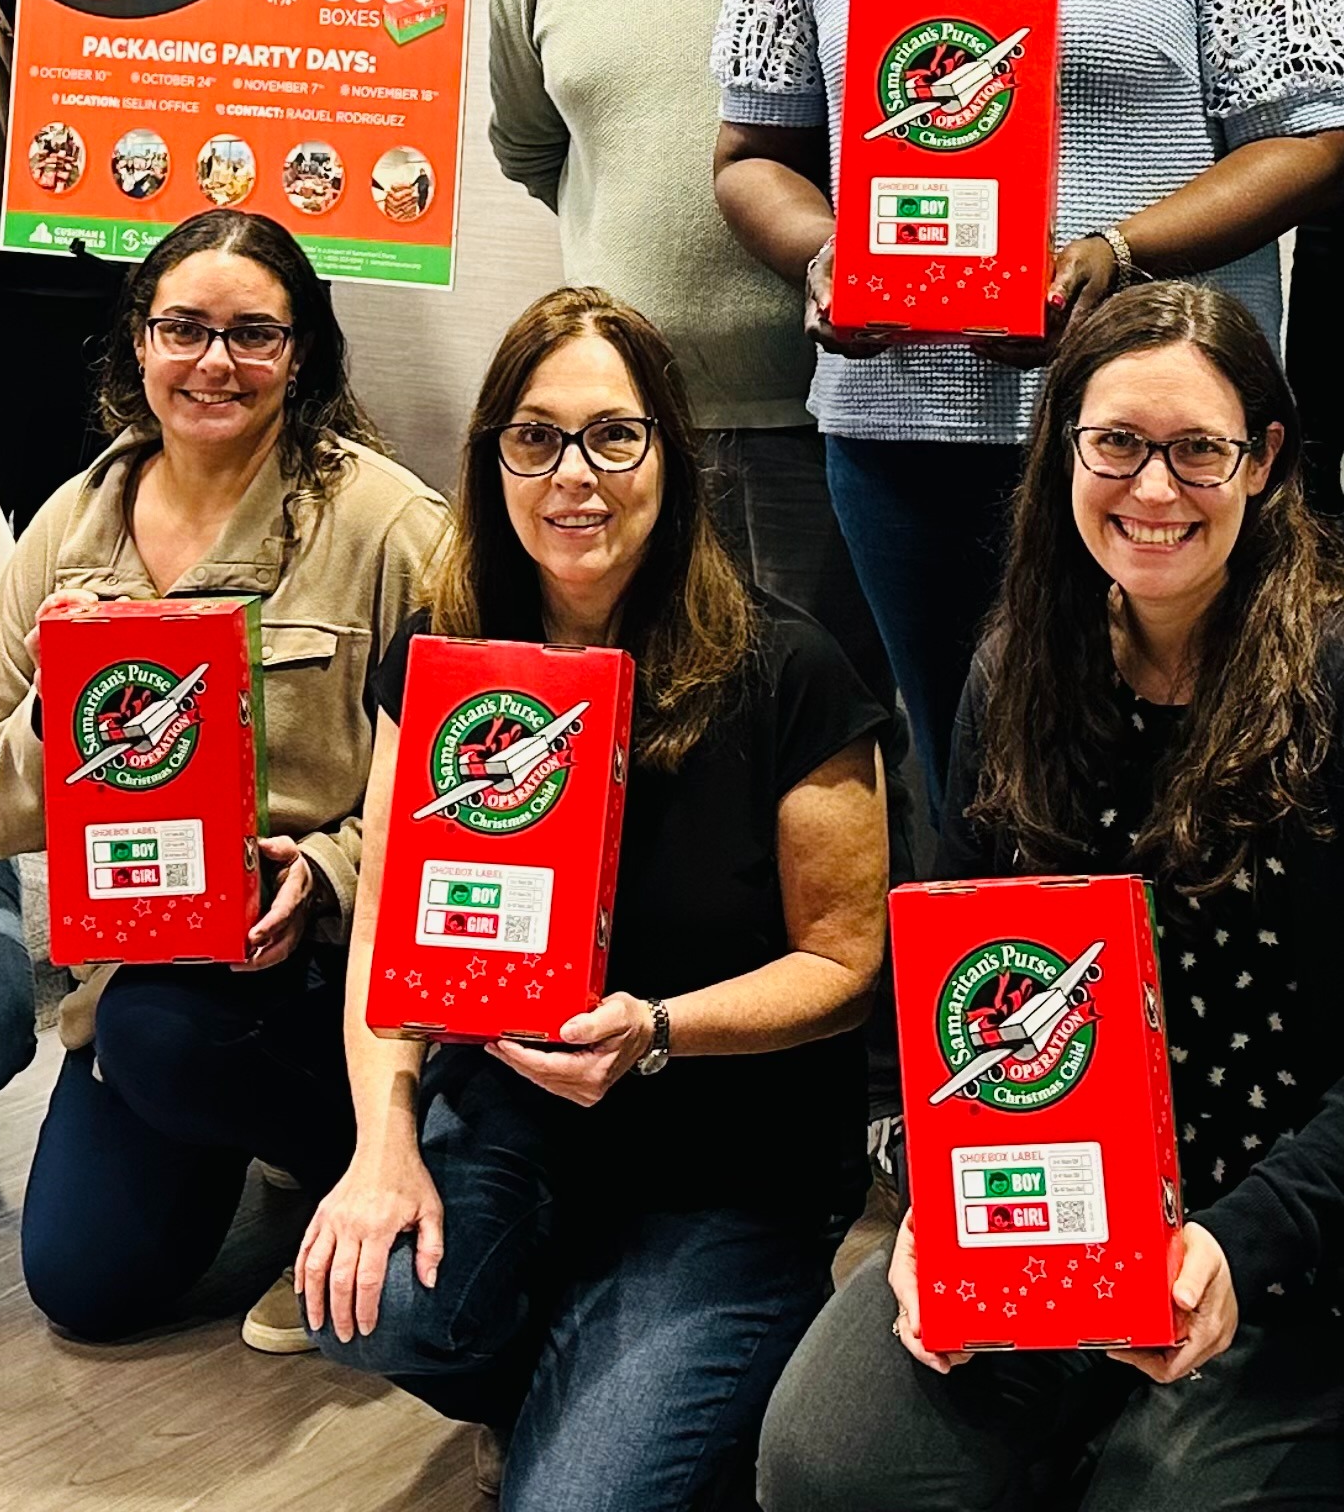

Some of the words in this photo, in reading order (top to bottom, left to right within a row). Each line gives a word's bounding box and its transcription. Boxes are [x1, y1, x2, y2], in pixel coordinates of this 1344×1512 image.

[318, 7, 380, 27] BOXES
[81, 36, 217, 65] PACKAGING
[221, 44, 301, 69] PARTY
[305, 47, 377, 74] DAYS:
[39, 66, 92, 82] OCTOBER
[886, 26, 940, 113] Samaritan's
[940, 22, 987, 54] Purse
[141, 72, 195, 88] OCTOBER
[242, 78, 309, 94] NOVEMBER
[60, 93, 121, 109] LOCATION:
[122, 96, 156, 111] ISELIN
[158, 99, 200, 114] OFFICE
[351, 85, 419, 101] NOVEMBER
[935, 77, 1006, 128] OPERATION
[226, 104, 285, 119] CONTACT:
[286, 106, 333, 123] RAQUEL
[335, 110, 406, 127] RODRIGUEZ
[918, 128, 981, 147] Christmas
[977, 101, 1004, 131] Child
[920, 199, 946, 215] BOY
[918, 226, 947, 242] GIRL
[82, 670, 127, 755] Samaritan's
[127, 664, 172, 693] Purse
[128, 713, 192, 767] OPERATION
[437, 697, 497, 791] Samaritan's
[499, 694, 545, 729] Purse
[116, 766, 173, 786] Christmas
[169, 738, 191, 768] Child
[486, 754, 561, 808] OPERATION
[468, 810, 533, 830] Christmas
[529, 781, 558, 813] Child
[131, 842, 156, 858] BOY
[131, 868, 159, 884] GIRL
[471, 886, 499, 905] BOY
[466, 916, 497, 935] GIRL
[949, 952, 1000, 1066] Samaritan's
[1001, 944, 1057, 981] Purse
[1009, 1010, 1085, 1080] OPERATION
[993, 1079, 1064, 1105] Christmas
[1059, 1041, 1087, 1081] Child
[959, 1151, 1009, 1163] SHOEBOX
[1011, 1150, 1046, 1161] LABEL
[1011, 1172, 1042, 1193] BOY
[1013, 1207, 1048, 1228] GIRL
